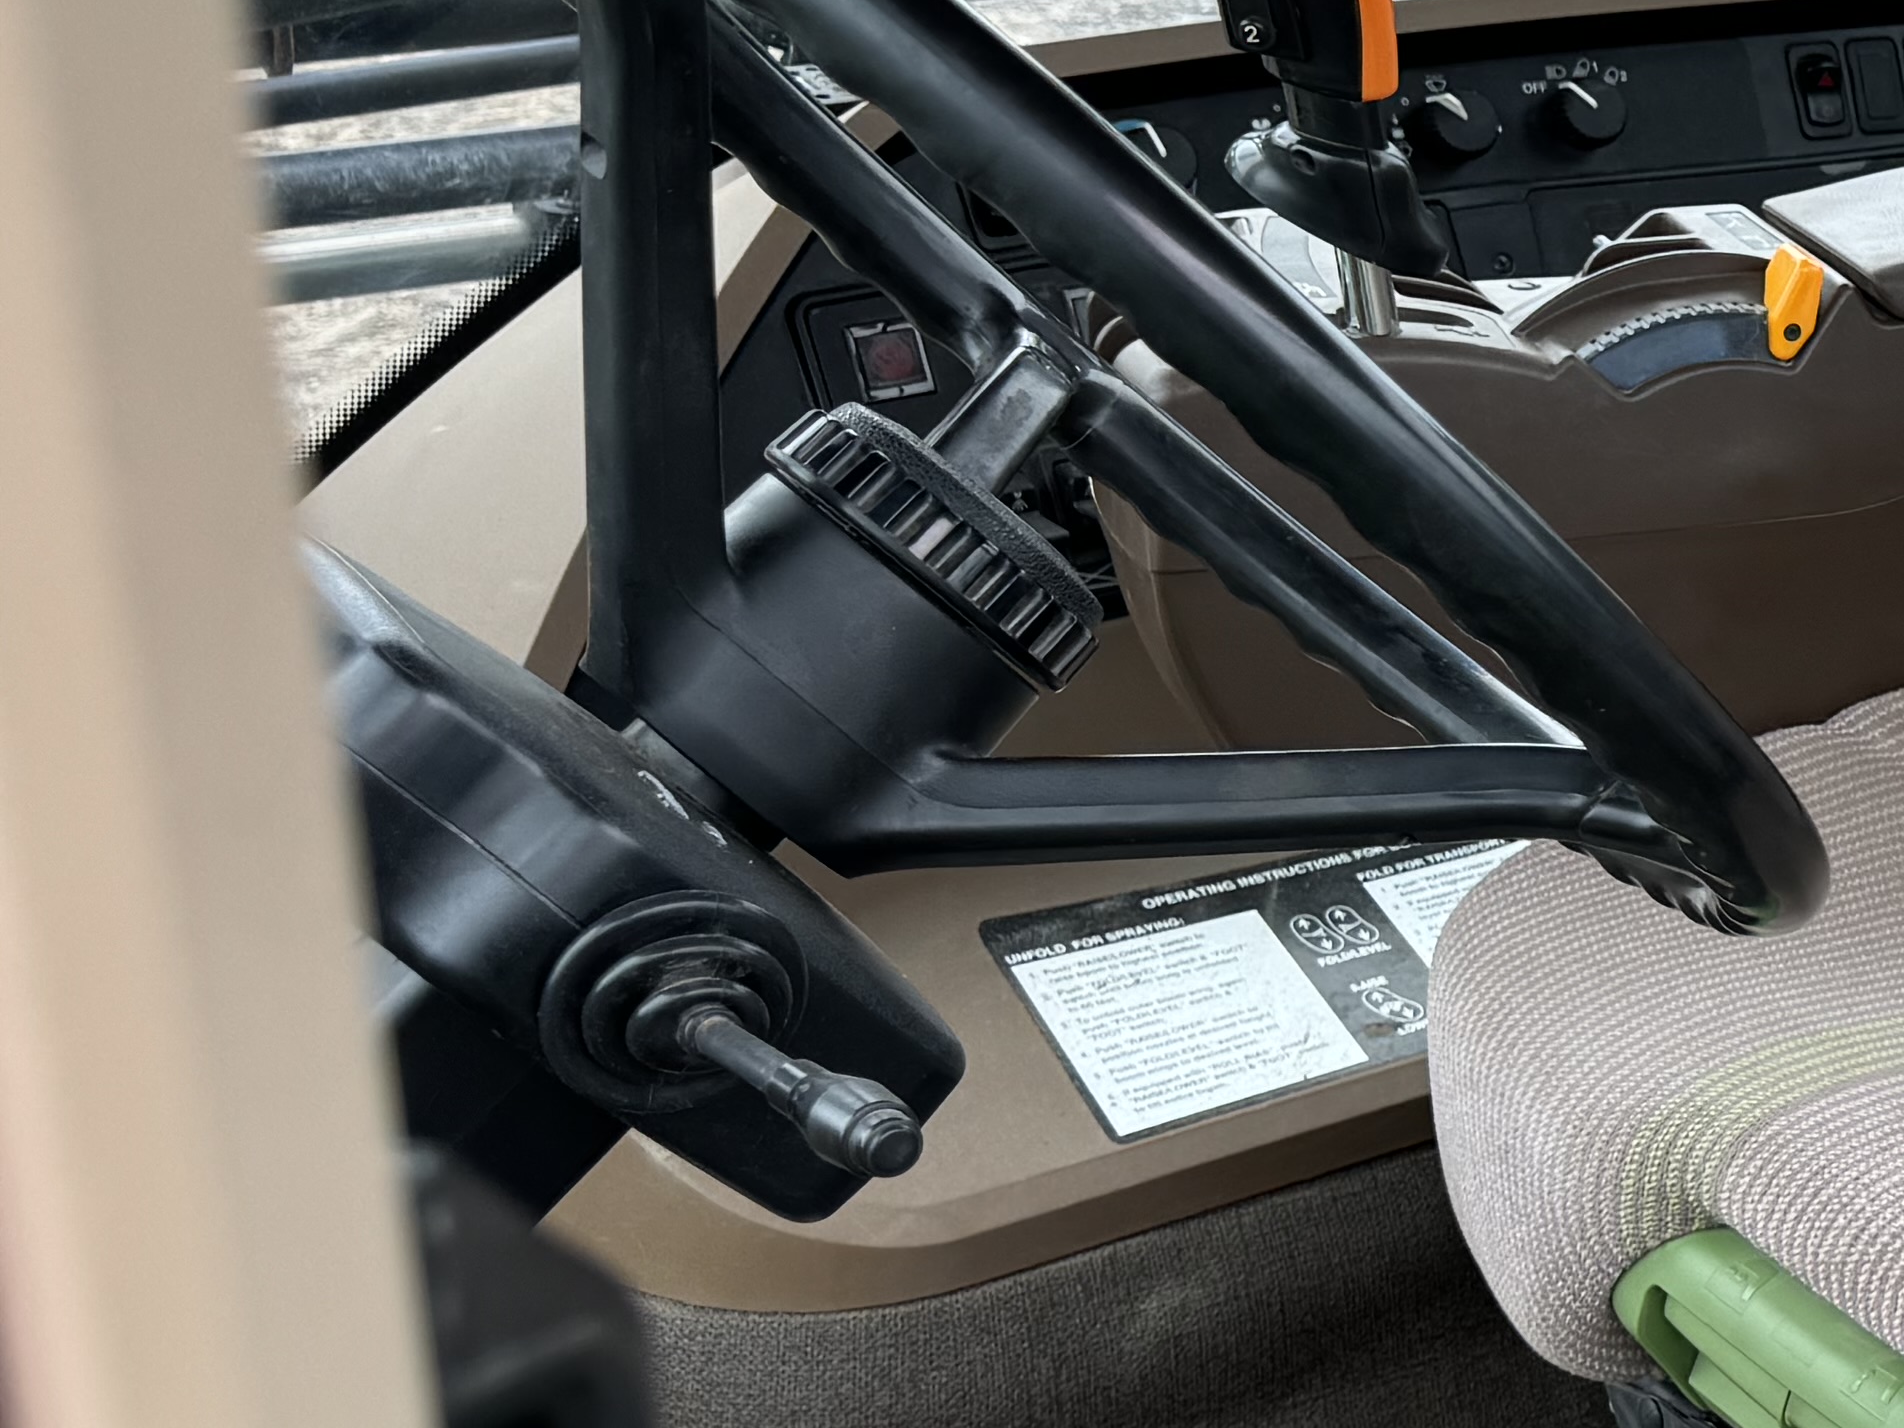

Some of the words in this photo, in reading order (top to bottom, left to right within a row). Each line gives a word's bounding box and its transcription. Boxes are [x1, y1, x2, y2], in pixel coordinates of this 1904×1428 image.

[1243, 25, 1260, 44] 2
[1521, 81, 1548, 95] OFF
[1141, 879, 1237, 910] OPERATING
[1237, 851, 1353, 889] INSTRUCTIONS
[1351, 845, 1388, 862] FOR
[1355, 864, 1395, 883] FOLD
[1395, 856, 1427, 872] FOR
[1003, 942, 1067, 966] UNFOLD
[1071, 933, 1105, 951] FOR
[1104, 916, 1186, 943] SPRAYING:
[1397, 1018, 1429, 1036] LOW
